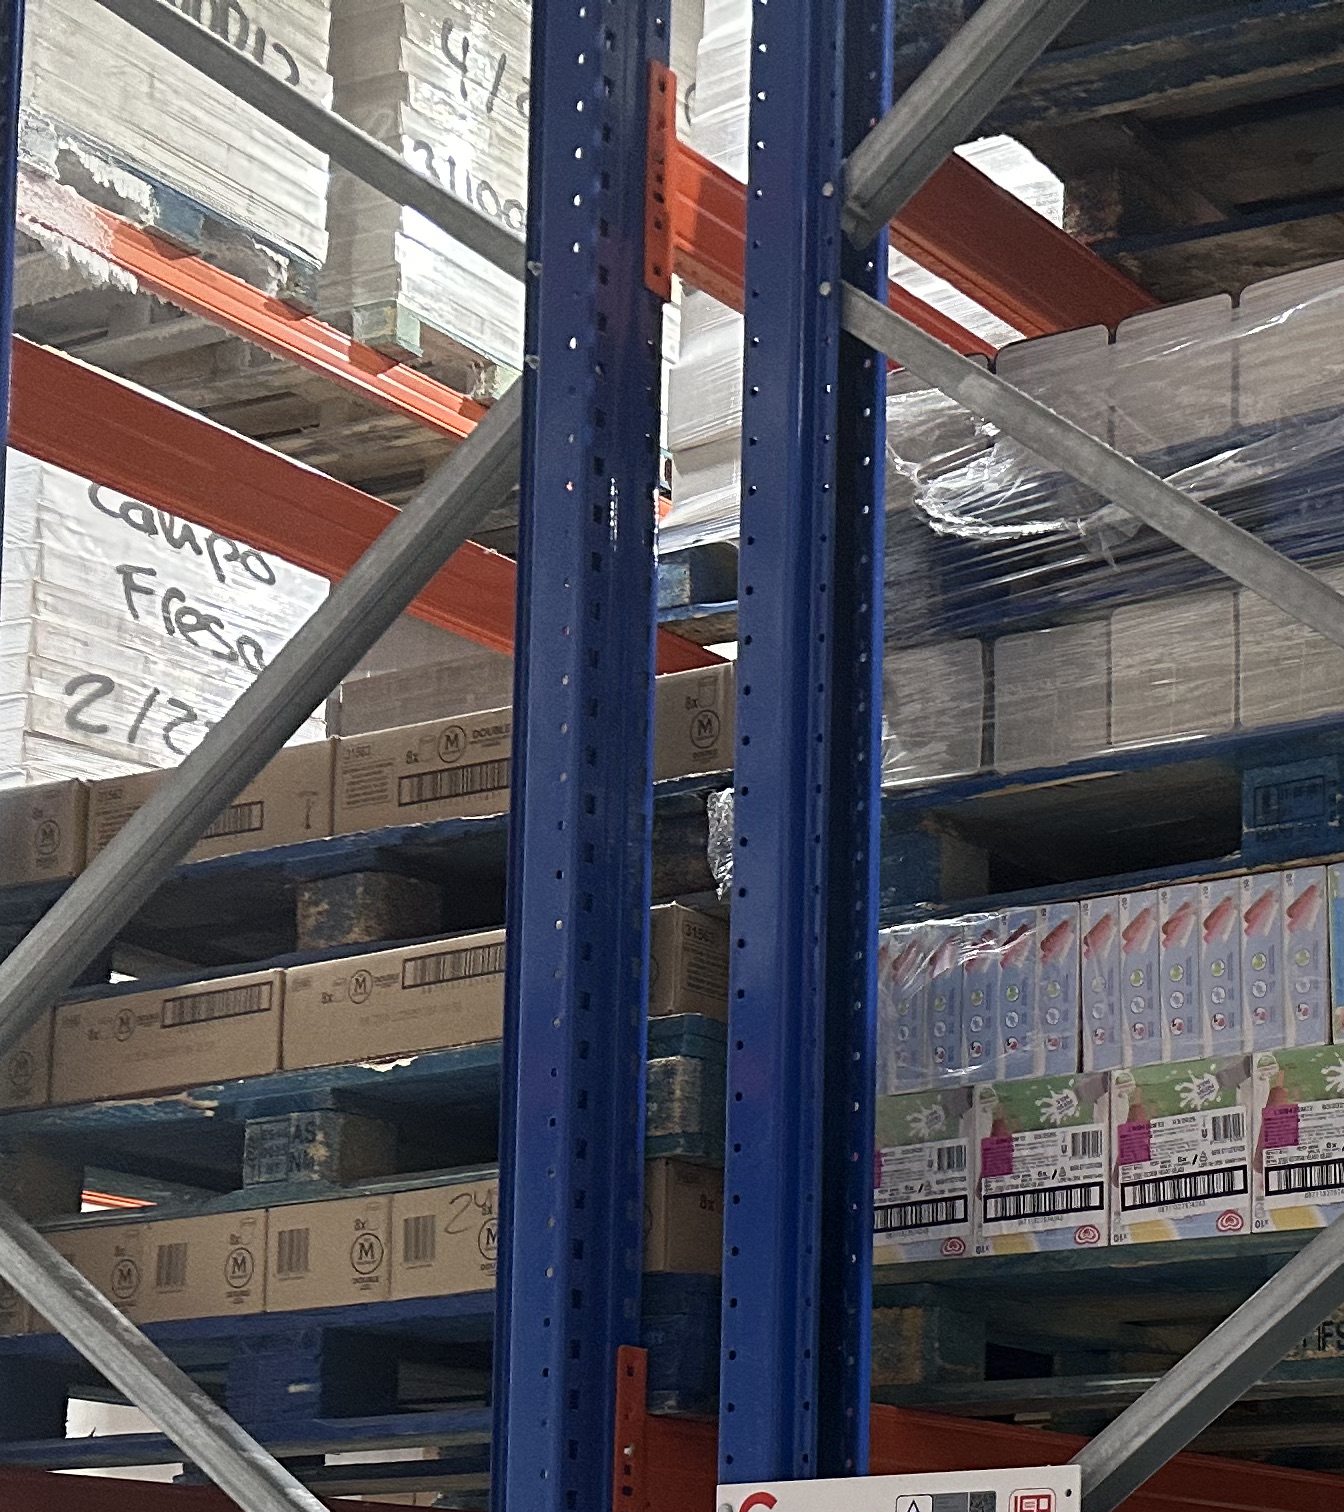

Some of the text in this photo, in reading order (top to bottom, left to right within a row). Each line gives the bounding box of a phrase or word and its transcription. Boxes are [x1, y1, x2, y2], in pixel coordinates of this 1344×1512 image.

[699, 717, 713, 735] M
[444, 733, 461, 753] M
[355, 976, 367, 990] M
[358, 1243, 375, 1262] M
[231, 1259, 248, 1274] M
